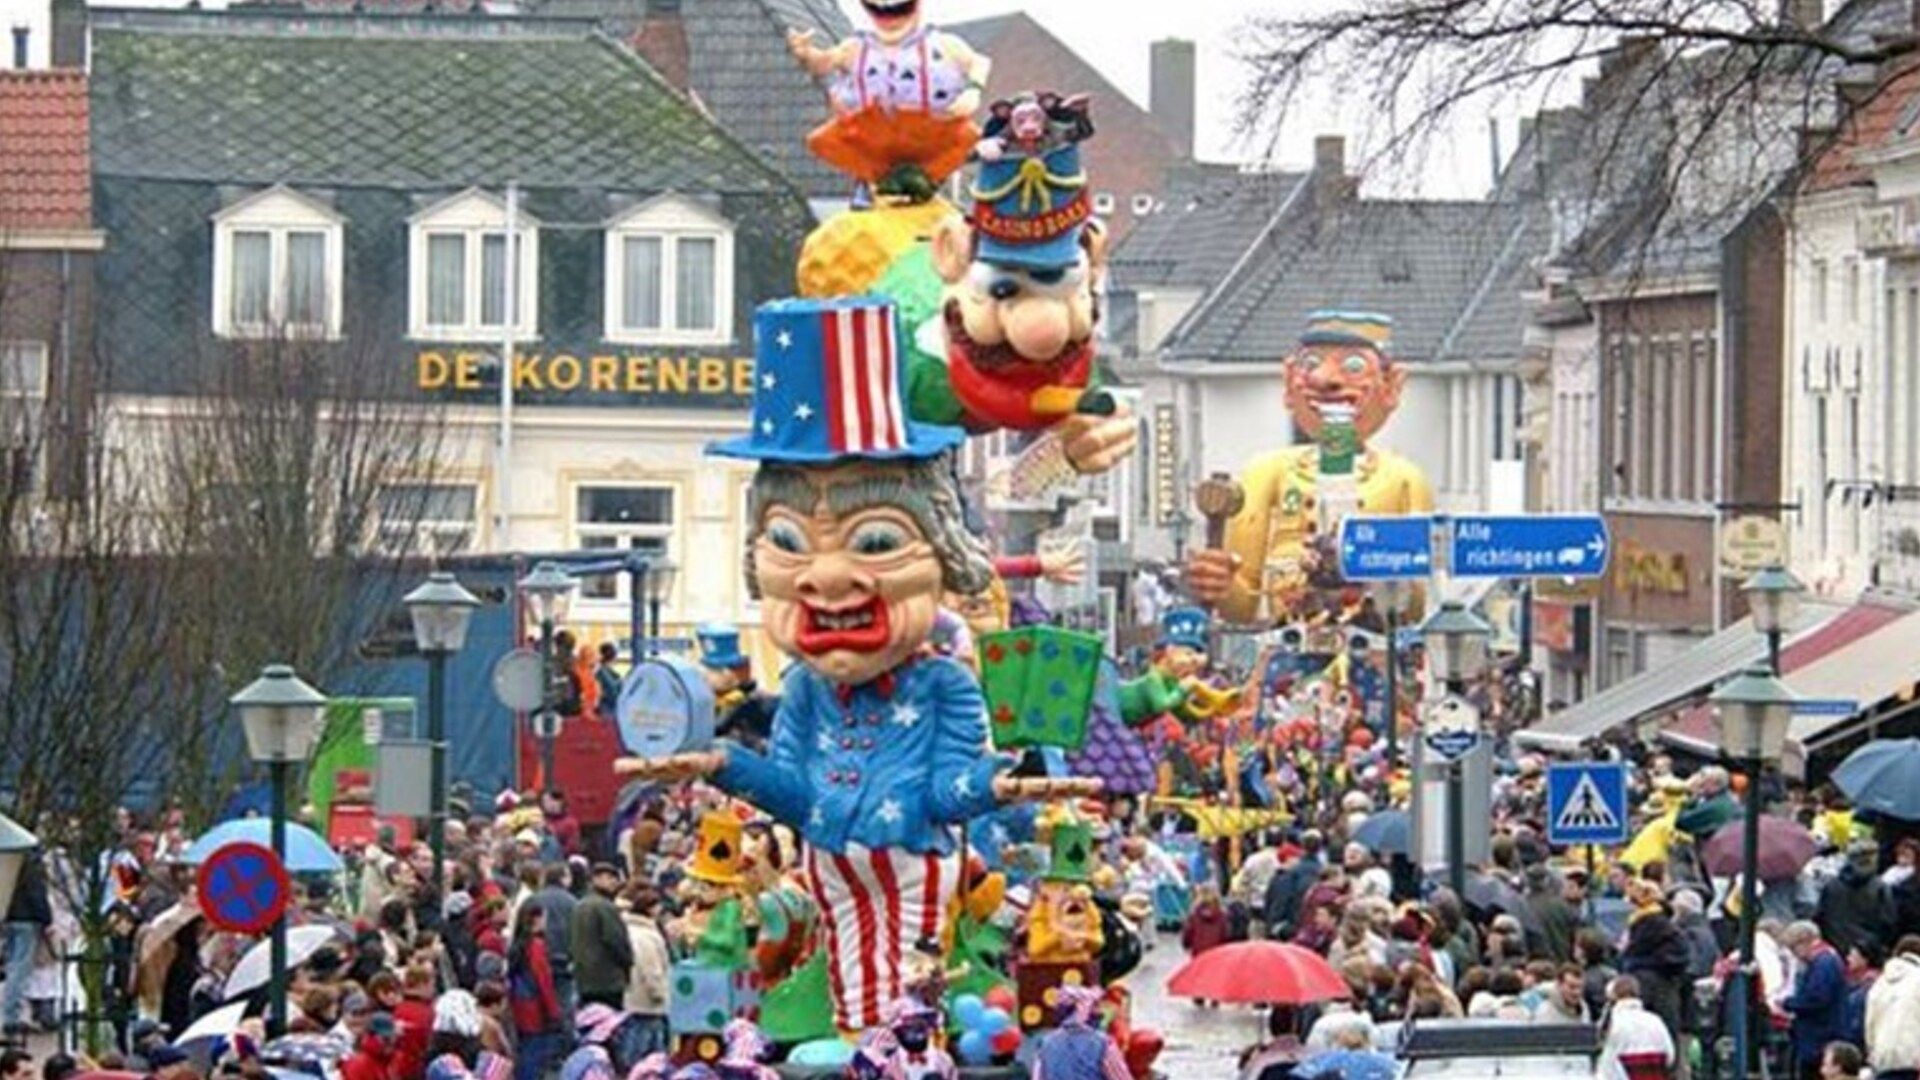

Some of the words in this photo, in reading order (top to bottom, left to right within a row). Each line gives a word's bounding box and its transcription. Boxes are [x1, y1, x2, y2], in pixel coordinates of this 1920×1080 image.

[418, 352, 482, 389] DE
[511, 354, 755, 393] KORENBE
[1458, 522, 1491, 541] Alle
[1466, 546, 1554, 570] richtingen
